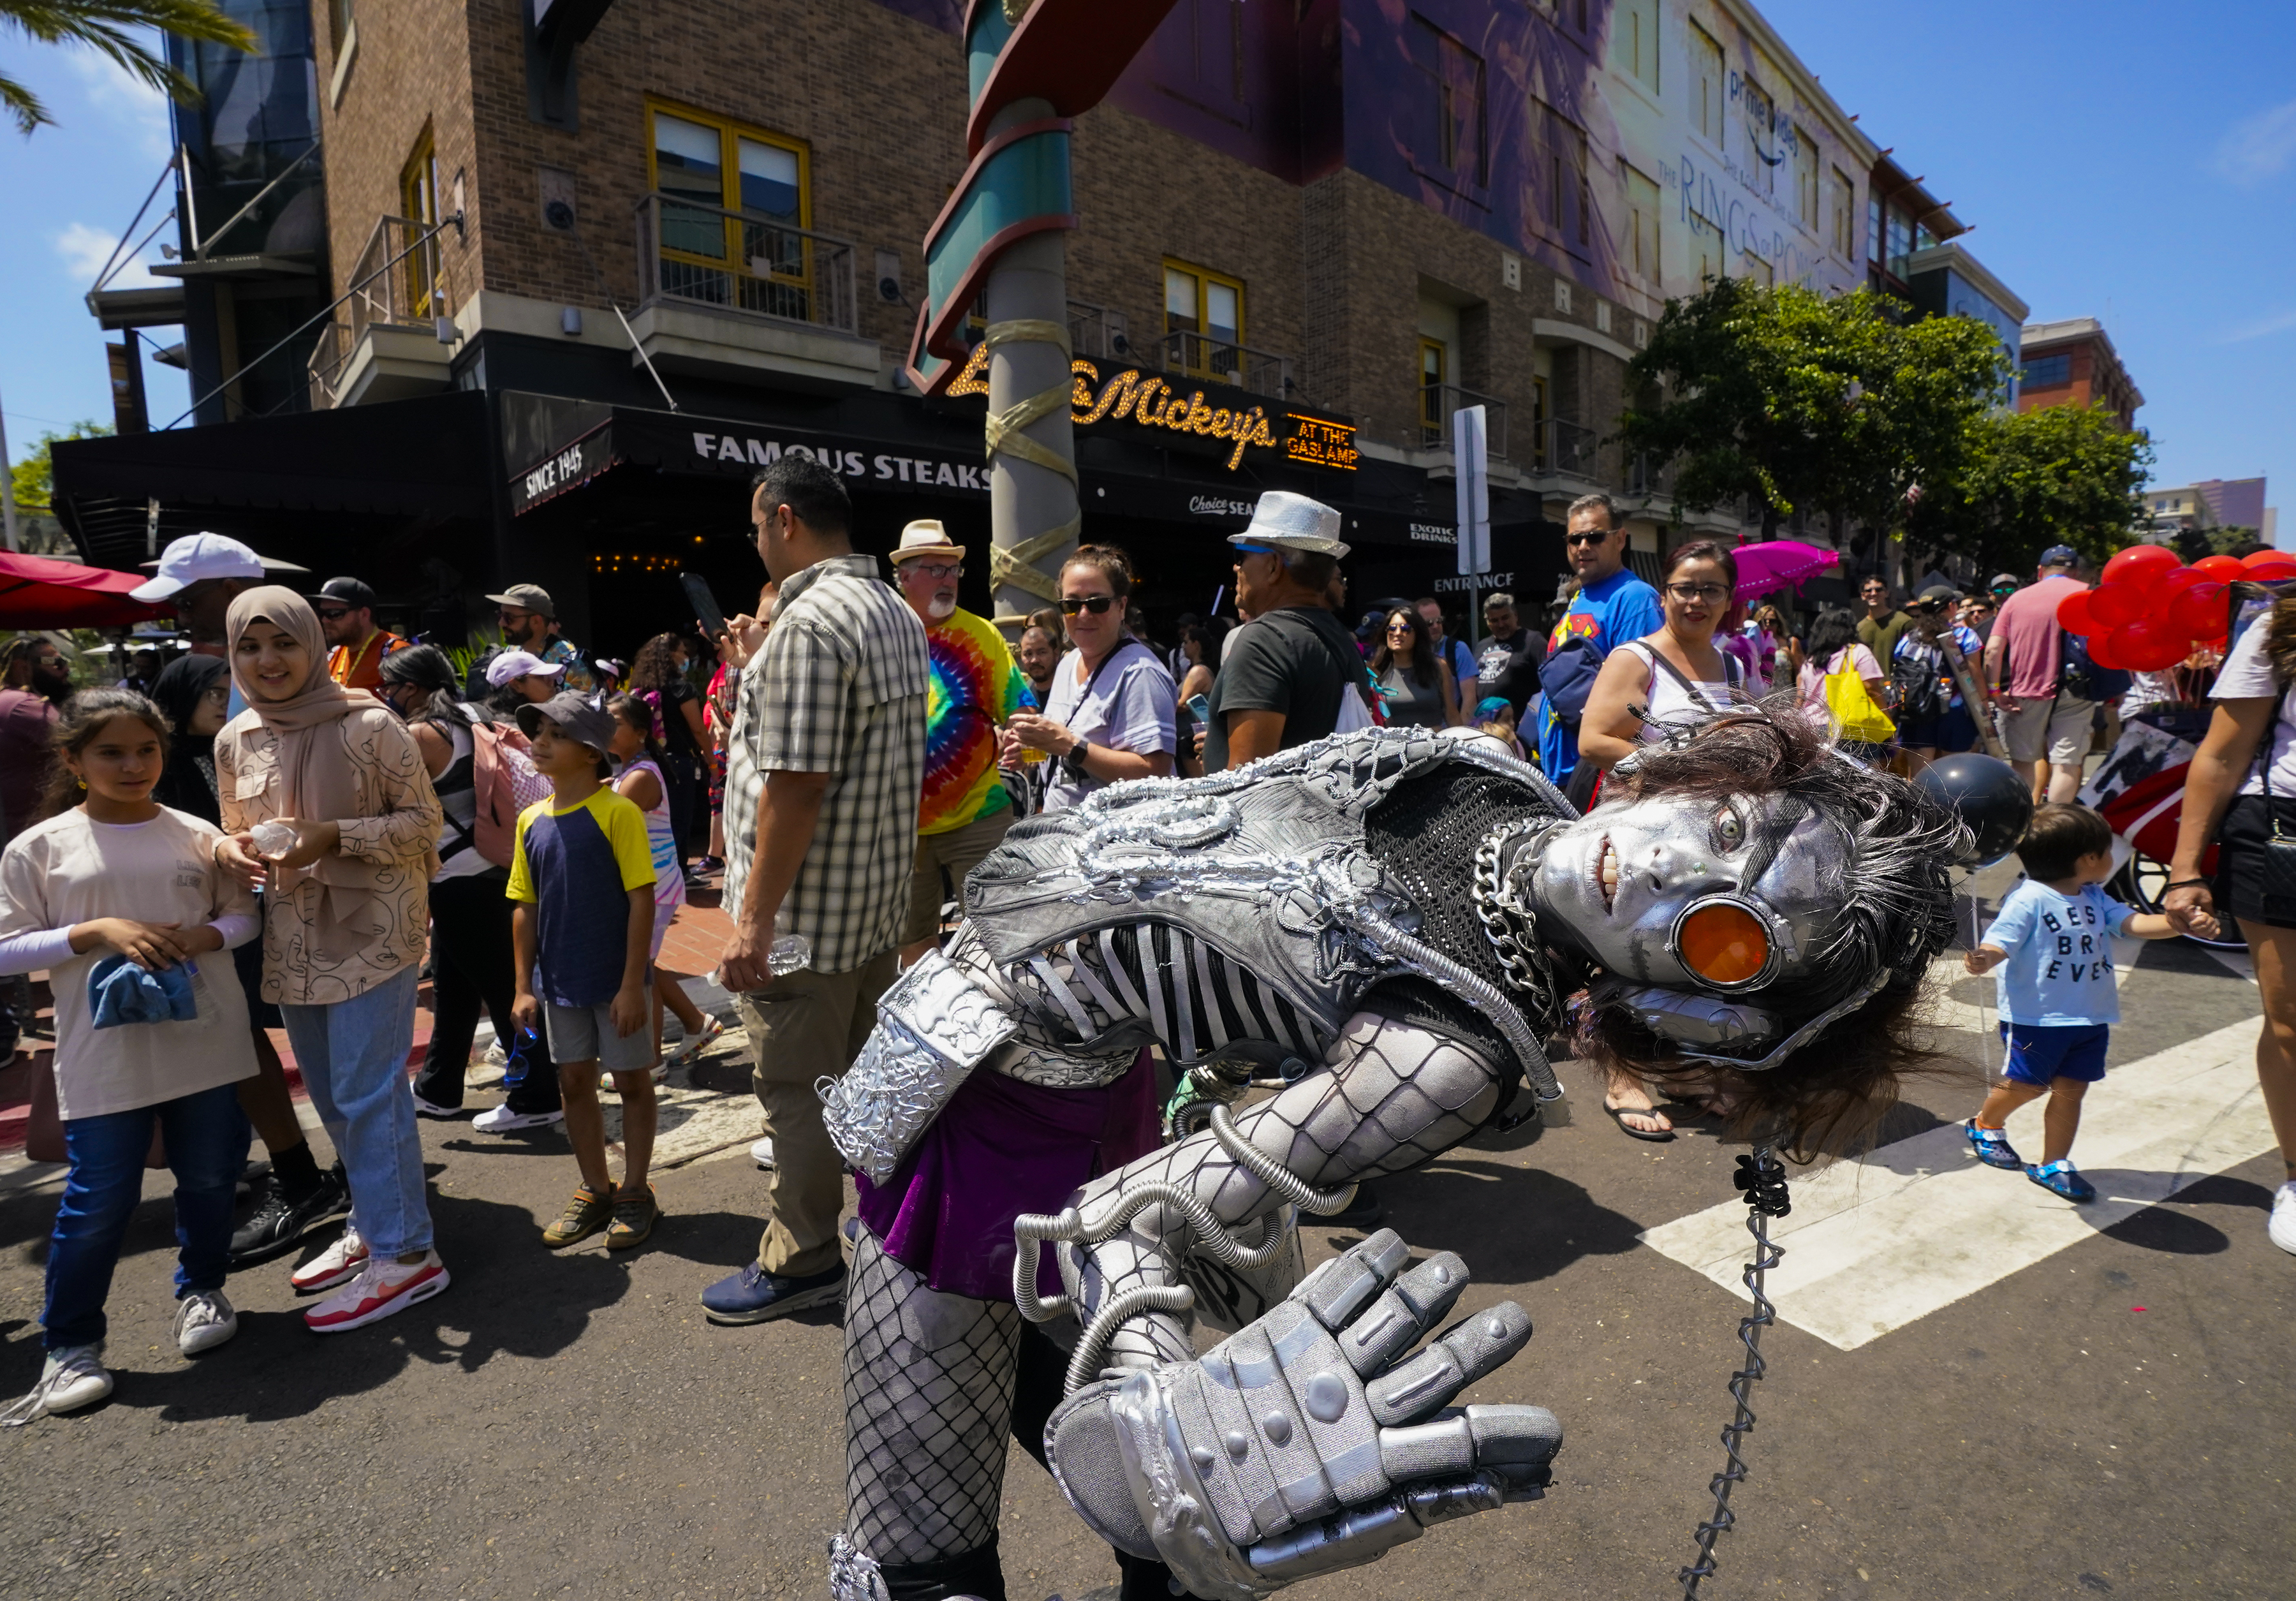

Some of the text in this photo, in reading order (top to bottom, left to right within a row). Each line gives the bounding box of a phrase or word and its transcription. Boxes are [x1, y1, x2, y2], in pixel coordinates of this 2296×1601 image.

[1730, 69, 1765, 126] prme
[1658, 160, 1677, 189] THE
[1681, 154, 1760, 267] RINGS
[1071, 359, 1277, 471] Mickey's
[1299, 422, 1350, 446] AT THE
[1287, 437, 1358, 464] GASLAMP
[526, 443, 582, 499] SINCE 1945
[1189, 495, 1257, 516] Choice SEA
[1409, 523, 1455, 536] EXOTIC
[1410, 531, 1459, 544] DRINKS
[2043, 905, 2096, 933] BES
[2057, 933, 2103, 955] BR
